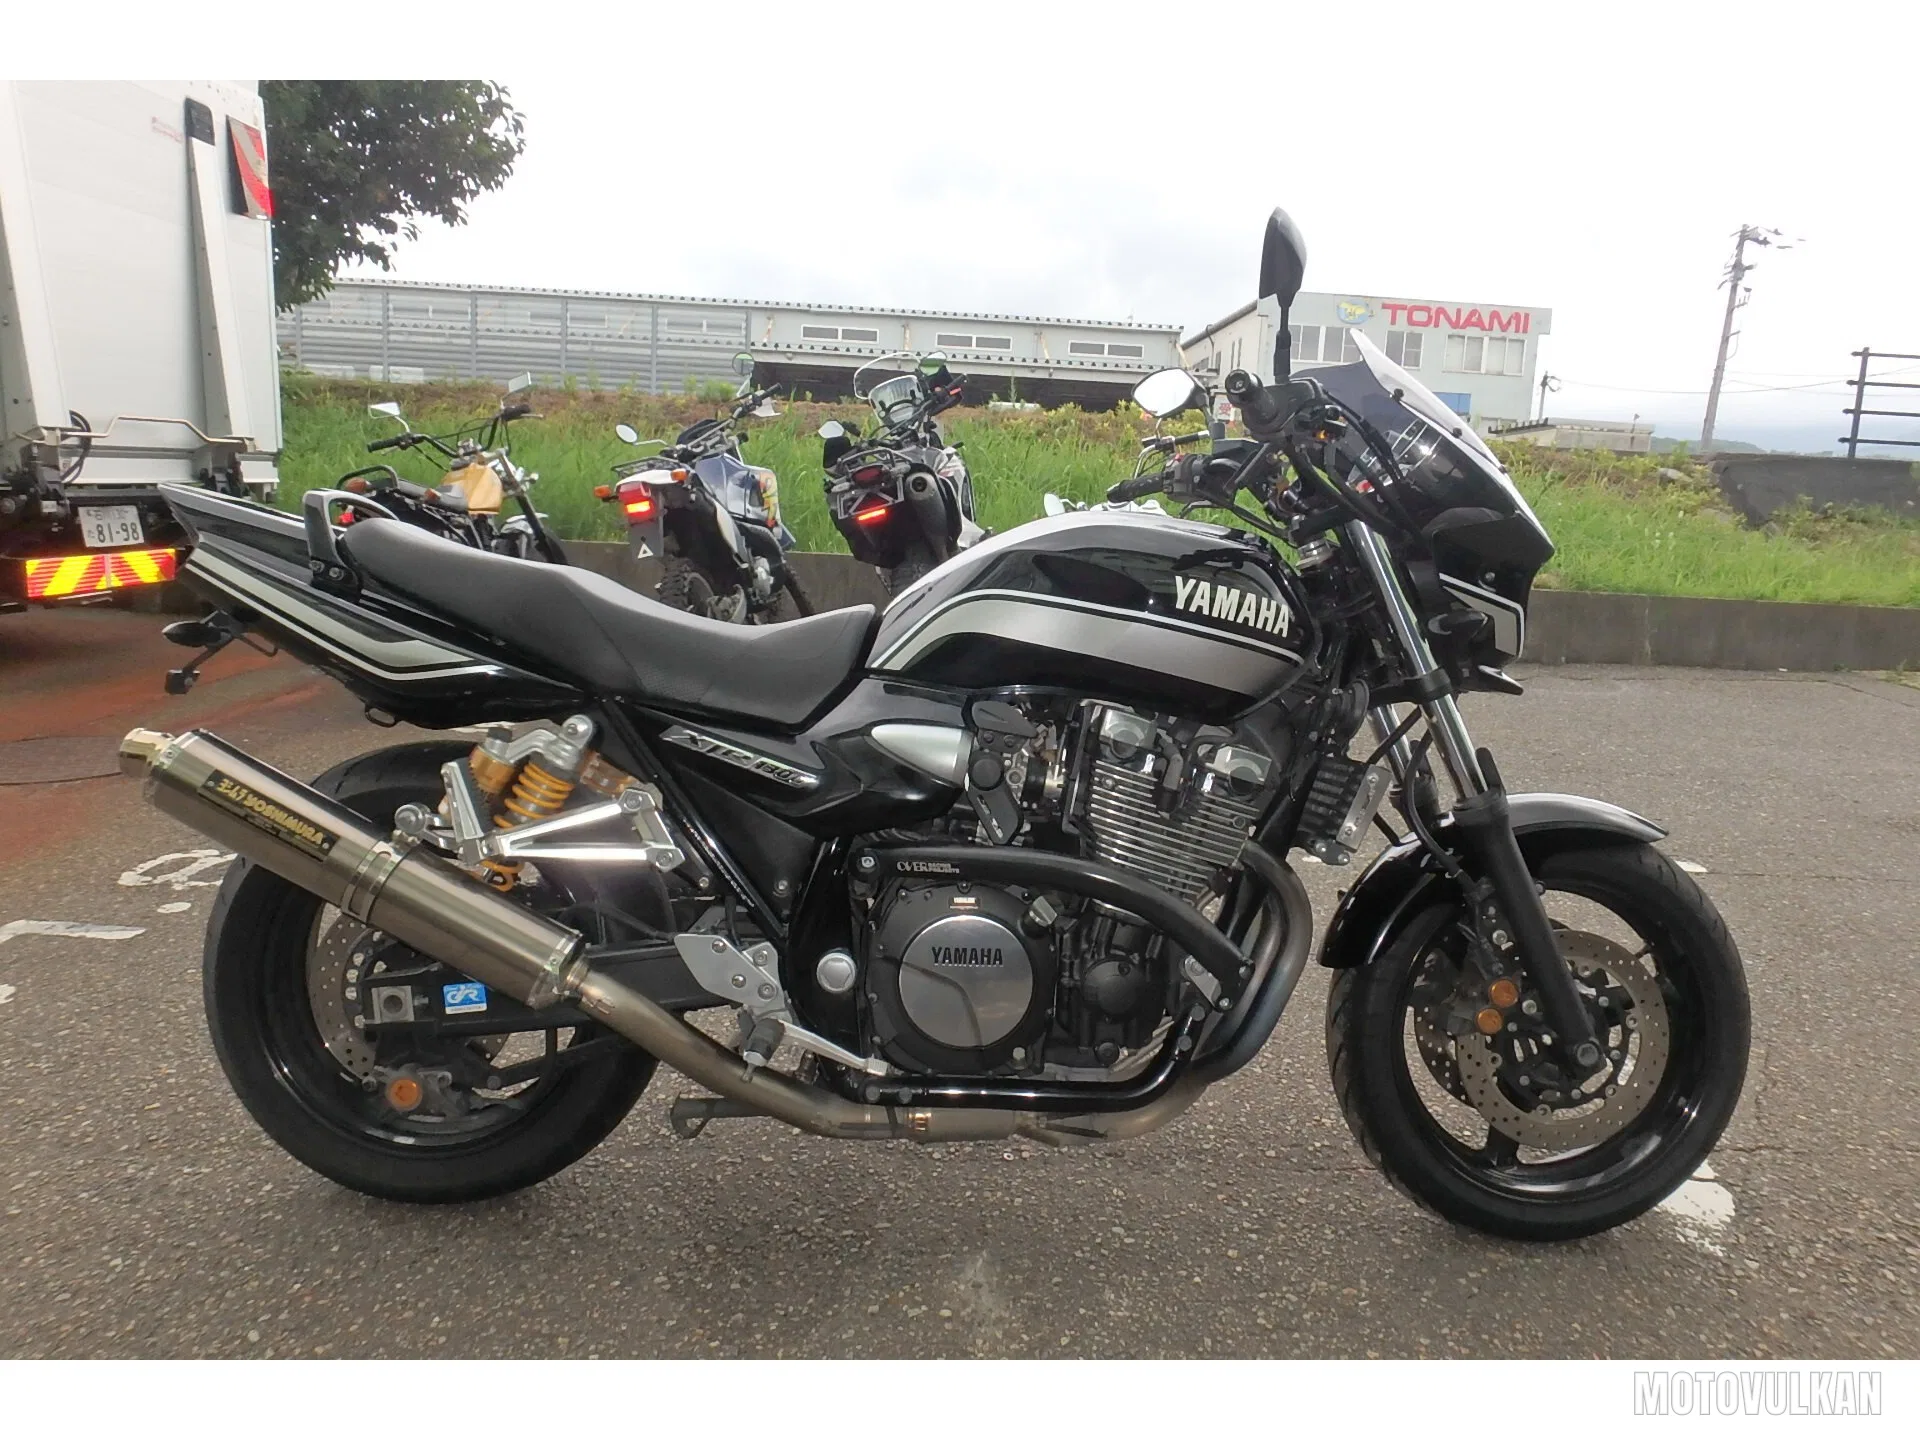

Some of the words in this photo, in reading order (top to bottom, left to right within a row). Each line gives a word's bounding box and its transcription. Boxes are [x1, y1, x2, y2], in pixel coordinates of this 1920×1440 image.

[1381, 303, 1530, 334] TONAMI
[96, 522, 140, 543] 81-98
[1175, 575, 1289, 638] YAMAHA
[243, 793, 324, 845] YOSHIMURA
[896, 861, 928, 872] OVER
[931, 946, 1003, 967] YAMAHA
